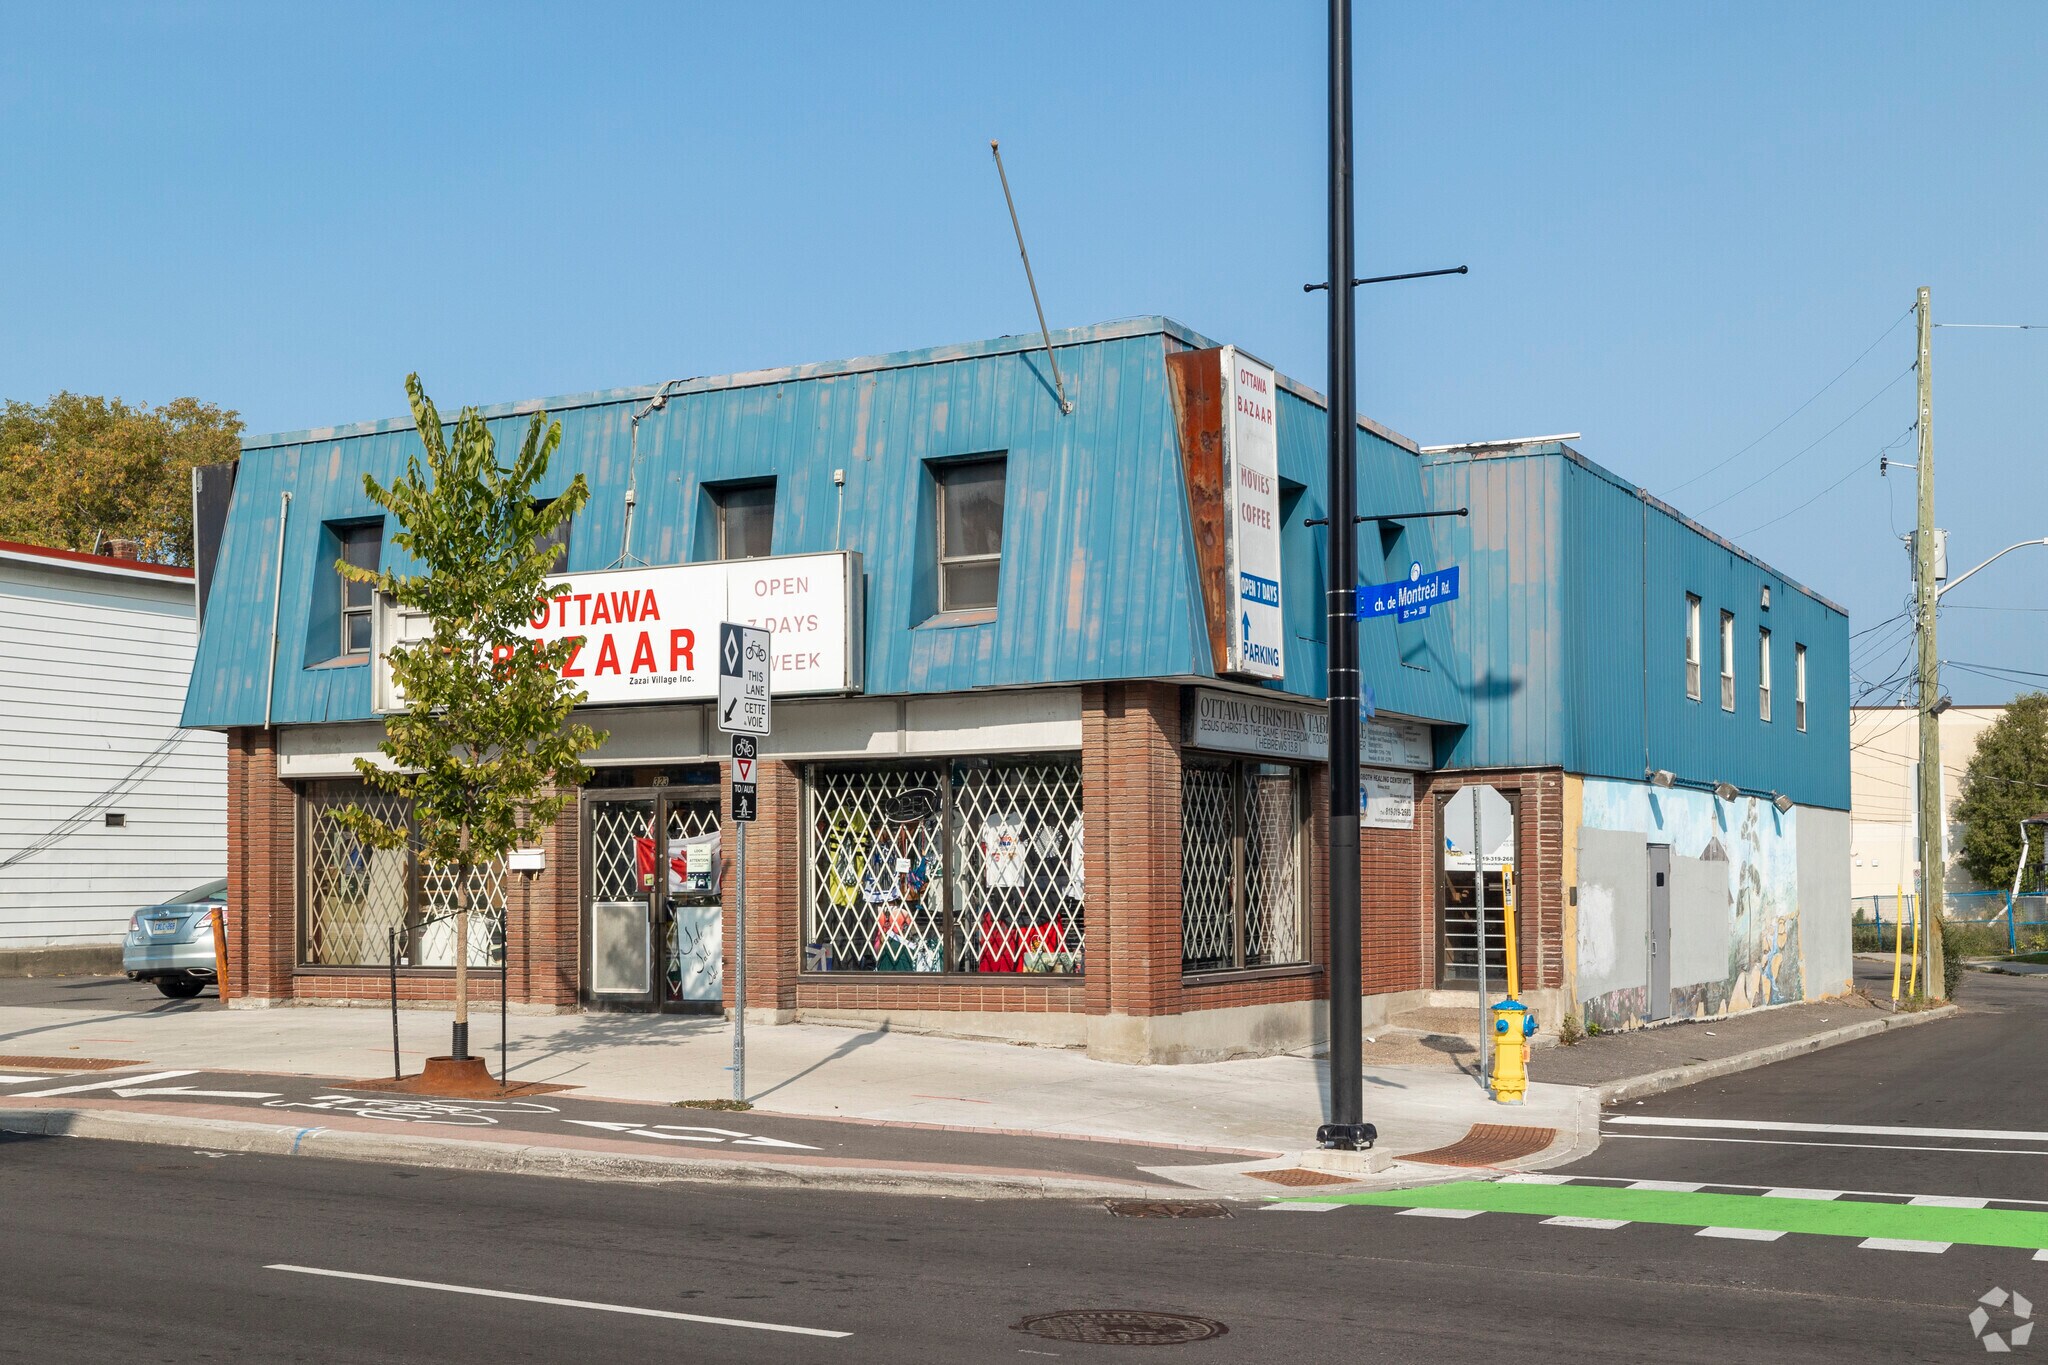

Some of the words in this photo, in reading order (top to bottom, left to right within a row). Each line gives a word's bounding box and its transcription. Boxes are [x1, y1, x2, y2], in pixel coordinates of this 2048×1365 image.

[1241, 369, 1267, 395] OTTAWA
[1237, 396, 1273, 426] BAZAAR
[1241, 467, 1270, 496] MOVIES
[1241, 502, 1271, 530] COFFEE
[755, 576, 809, 597] OPEN
[1241, 576, 1257, 597] OPEN
[1262, 583, 1278, 603] DAYS
[1374, 598, 1385, 612] ch.
[1388, 596, 1396, 608] de
[1398, 576, 1438, 606] Montréal
[1441, 580, 1450, 596] Rd.
[529, 589, 661, 630] OTTAWA
[765, 614, 818, 634] DAYS
[1244, 641, 1280, 668] PARKING
[629, 676, 649, 686] Zazai
[652, 675, 677, 686] Village
[680, 674, 695, 683] Inc.
[748, 670, 764, 683] THIS
[746, 684, 764, 697] LANE
[744, 702, 766, 716] CETTE
[746, 715, 763, 728] VOIE
[1200, 697, 1248, 723] OTTAWA
[1250, 704, 1306, 731] CHRISTIAN
[1200, 719, 1220, 732] JESUS
[1220, 721, 1242, 734] CHRIST
[1243, 724, 1249, 735] IS
[1250, 725, 1262, 736] THE
[1262, 726, 1279, 739] SAME
[1280, 729, 1312, 744] YESTERDAY,
[652, 776, 669, 786] 323
[1374, 774, 1390, 783] HEALING
[680, 922, 704, 955] Sale
